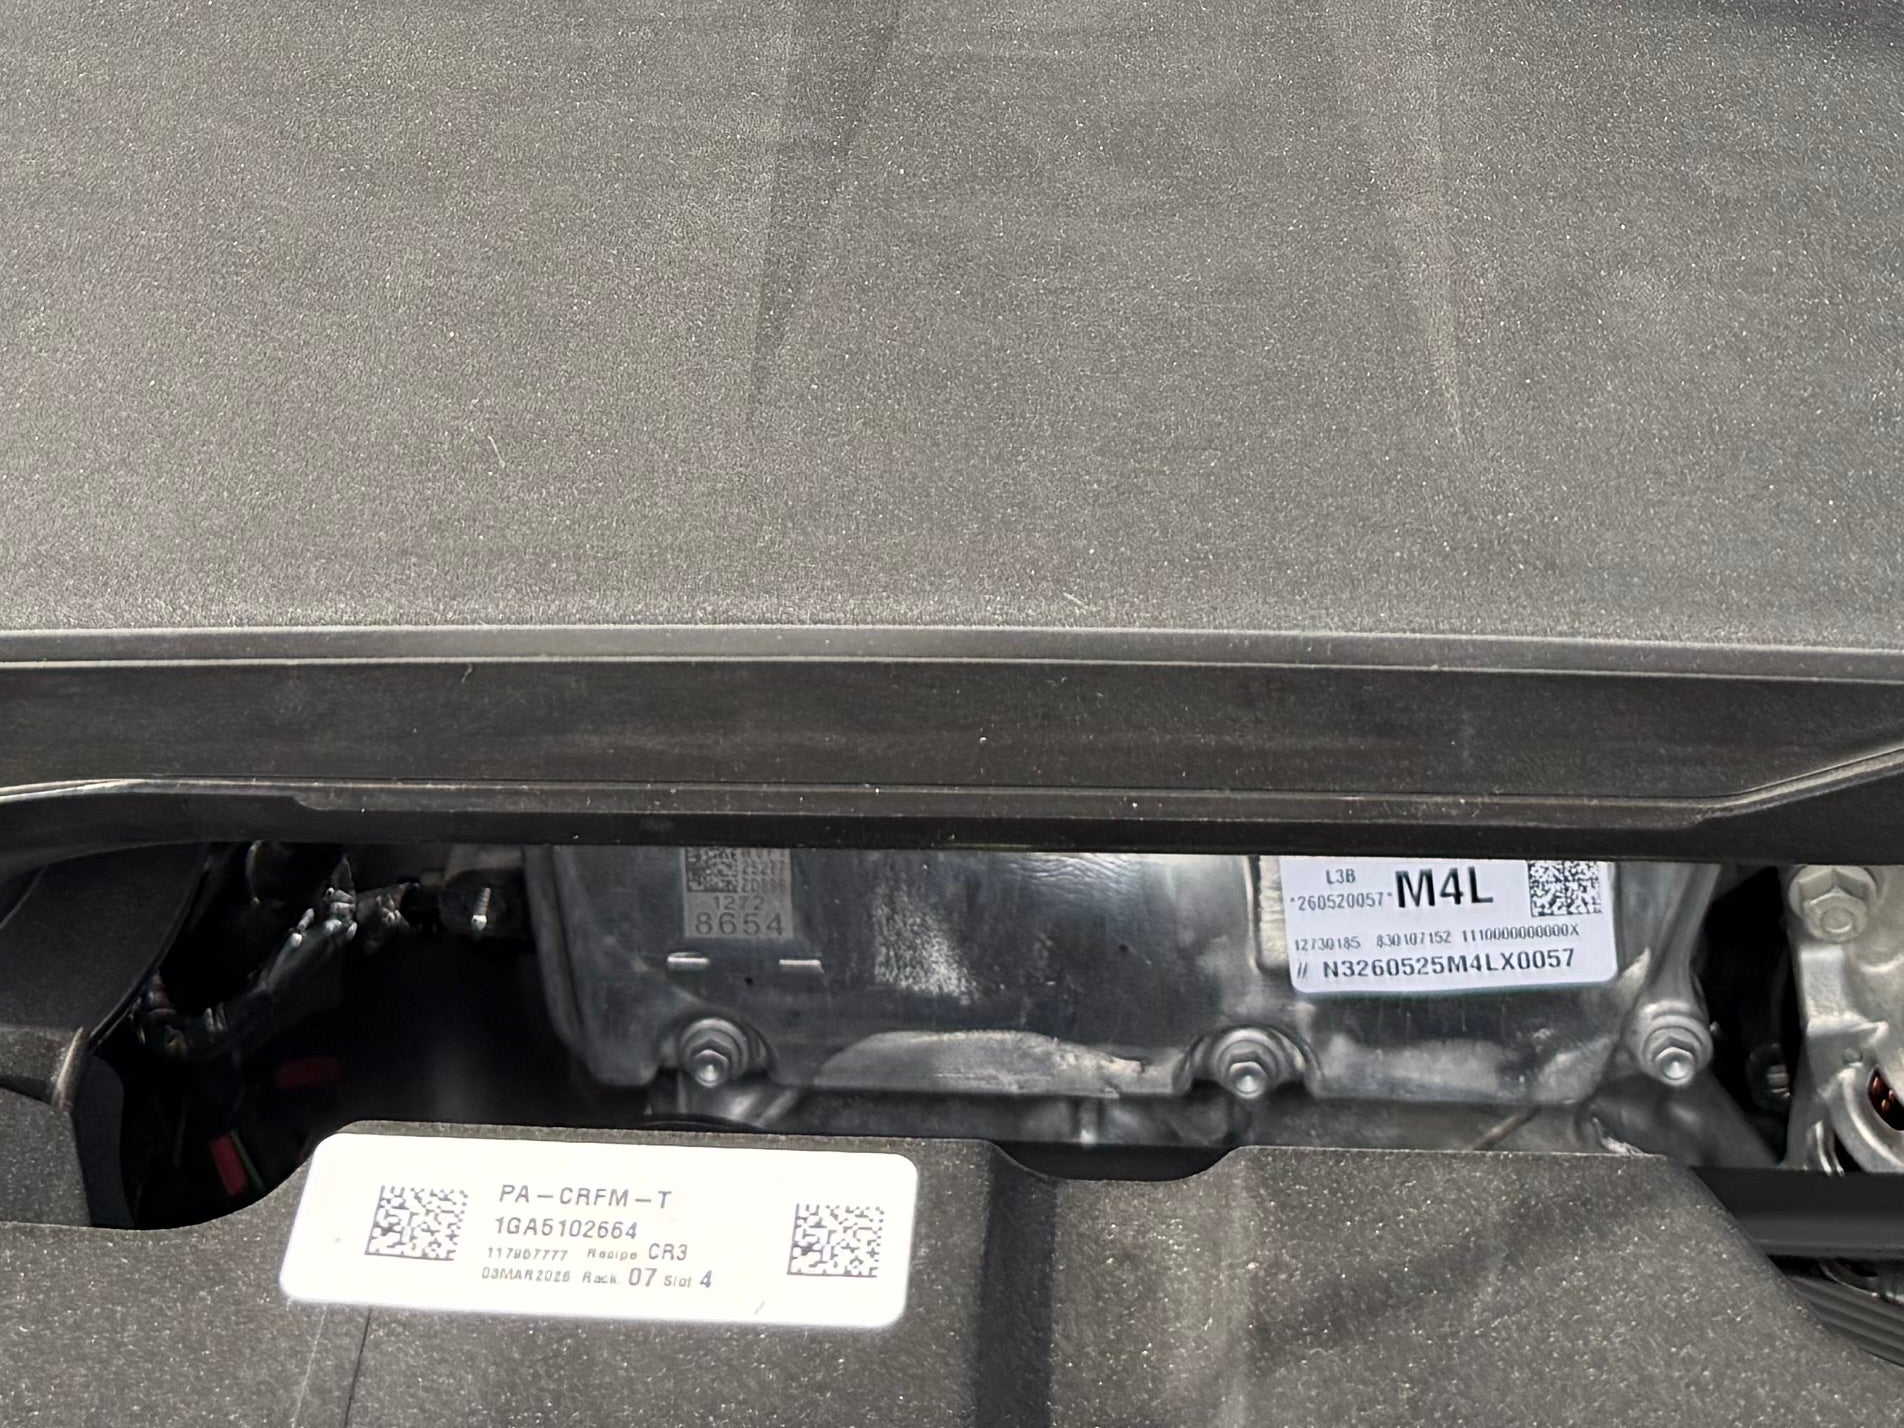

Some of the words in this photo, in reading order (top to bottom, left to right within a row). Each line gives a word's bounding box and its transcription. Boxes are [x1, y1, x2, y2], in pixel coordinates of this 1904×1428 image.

[1325, 868, 1356, 885] L3B
[1395, 866, 1494, 908] M4L
[713, 895, 765, 911] 1272
[695, 912, 784, 936] 8654
[1323, 948, 1575, 978] N3260525M4LX0057
[495, 1216, 638, 1240] 1GA5102664
[648, 1242, 688, 1261] CR3
[628, 1267, 658, 1287] 07
[699, 1269, 713, 1288] 4
